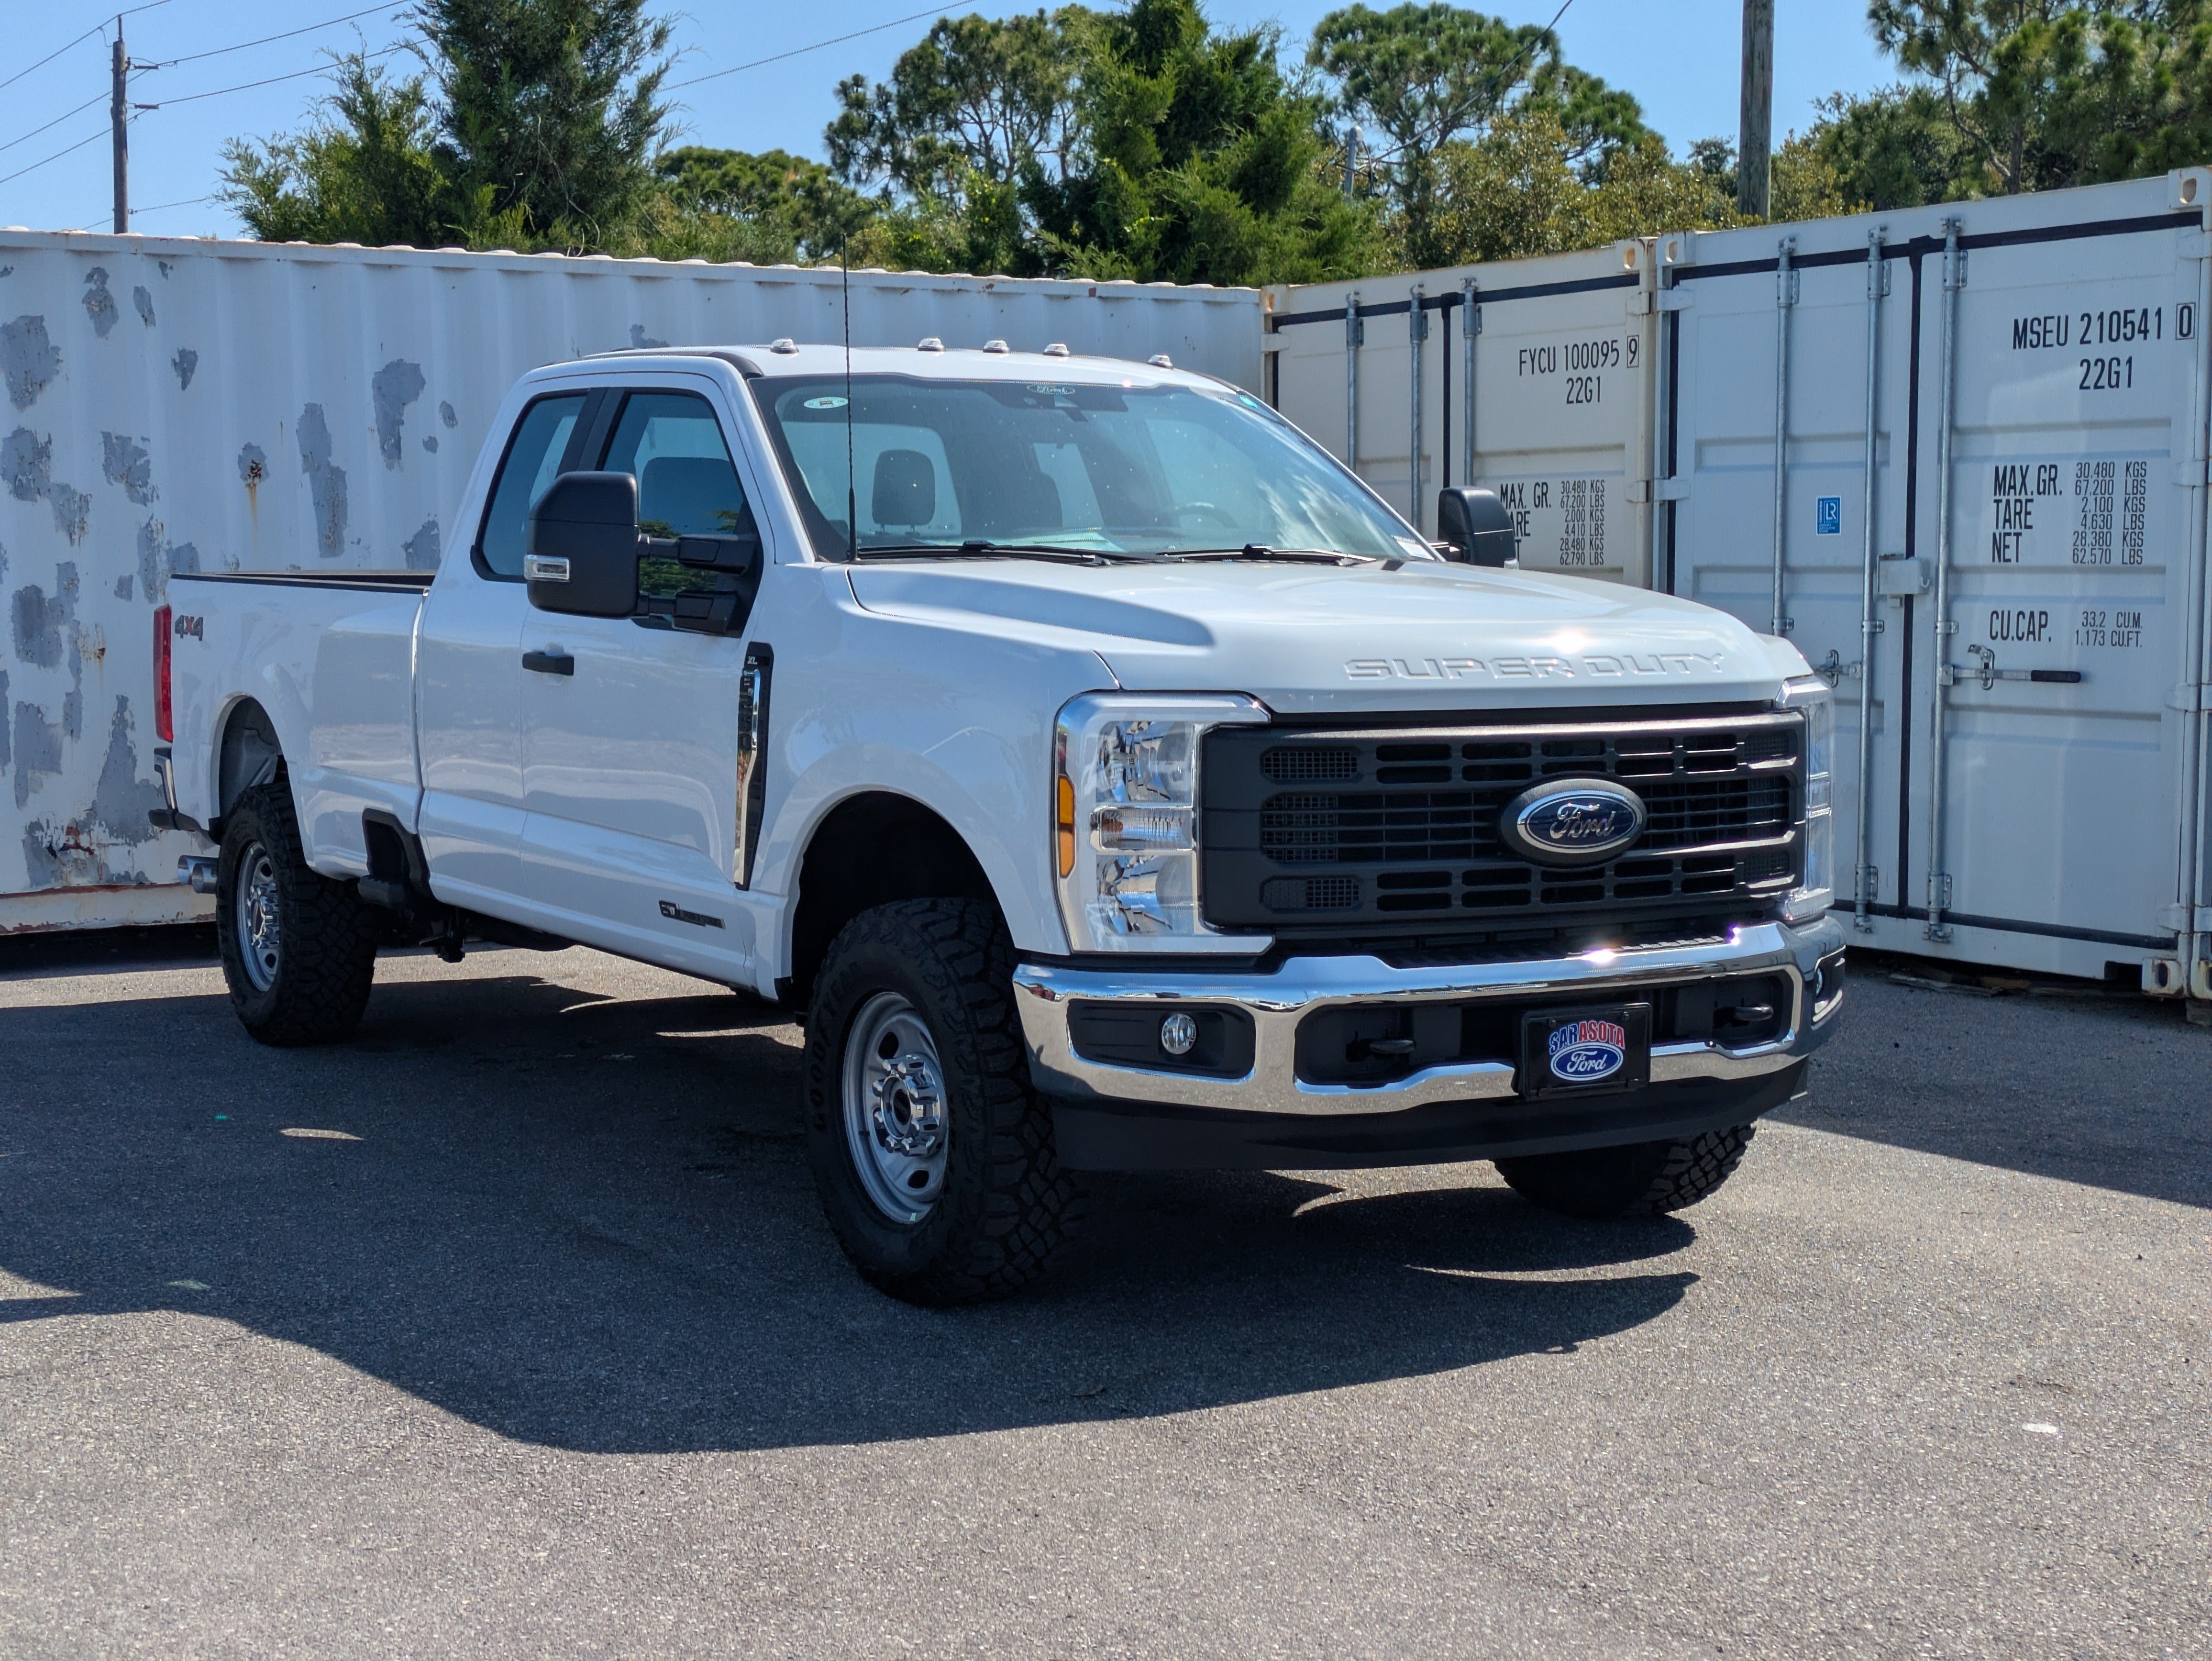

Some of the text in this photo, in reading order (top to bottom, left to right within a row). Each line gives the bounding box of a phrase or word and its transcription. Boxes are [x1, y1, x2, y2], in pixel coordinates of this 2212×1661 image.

[2013, 305, 2192, 350] MSEU 210541 0
[1519, 338, 1638, 376] FYCU 100095 9
[2079, 355, 2133, 390] 22G1
[1566, 376, 1601, 404] 22G1
[2125, 461, 2147, 478] KGS
[1500, 482, 1527, 509] MAX.
[1533, 482, 1551, 508] GR.
[1590, 479, 1605, 494] KGS
[2124, 478, 2146, 496] LBS
[1590, 494, 1604, 508] LBS
[1826, 502, 1836, 520] LR
[1590, 509, 1604, 522] KGS
[1993, 498, 2034, 530] TARE
[2124, 496, 2146, 513] KGS
[2123, 513, 2145, 530] LBS
[1589, 523, 1604, 536] LBS
[1589, 537, 1604, 551] KGS
[1991, 532, 2023, 563] NET
[2122, 531, 2144, 547] KGS
[1589, 551, 1604, 565] LBS
[2121, 548, 2143, 565] LBS
[1989, 610, 2143, 642] CU.CAP. 33.2 CU.M.
[2111, 630, 2142, 647] CU.FT.
[747, 655, 759, 665] XL
[1343, 653, 1724, 680] SUPER DUTY
[1549, 802, 1616, 839] Ford
[1548, 1020, 1626, 1055] SARASOTA
[1566, 1050, 1608, 1073] Ford
